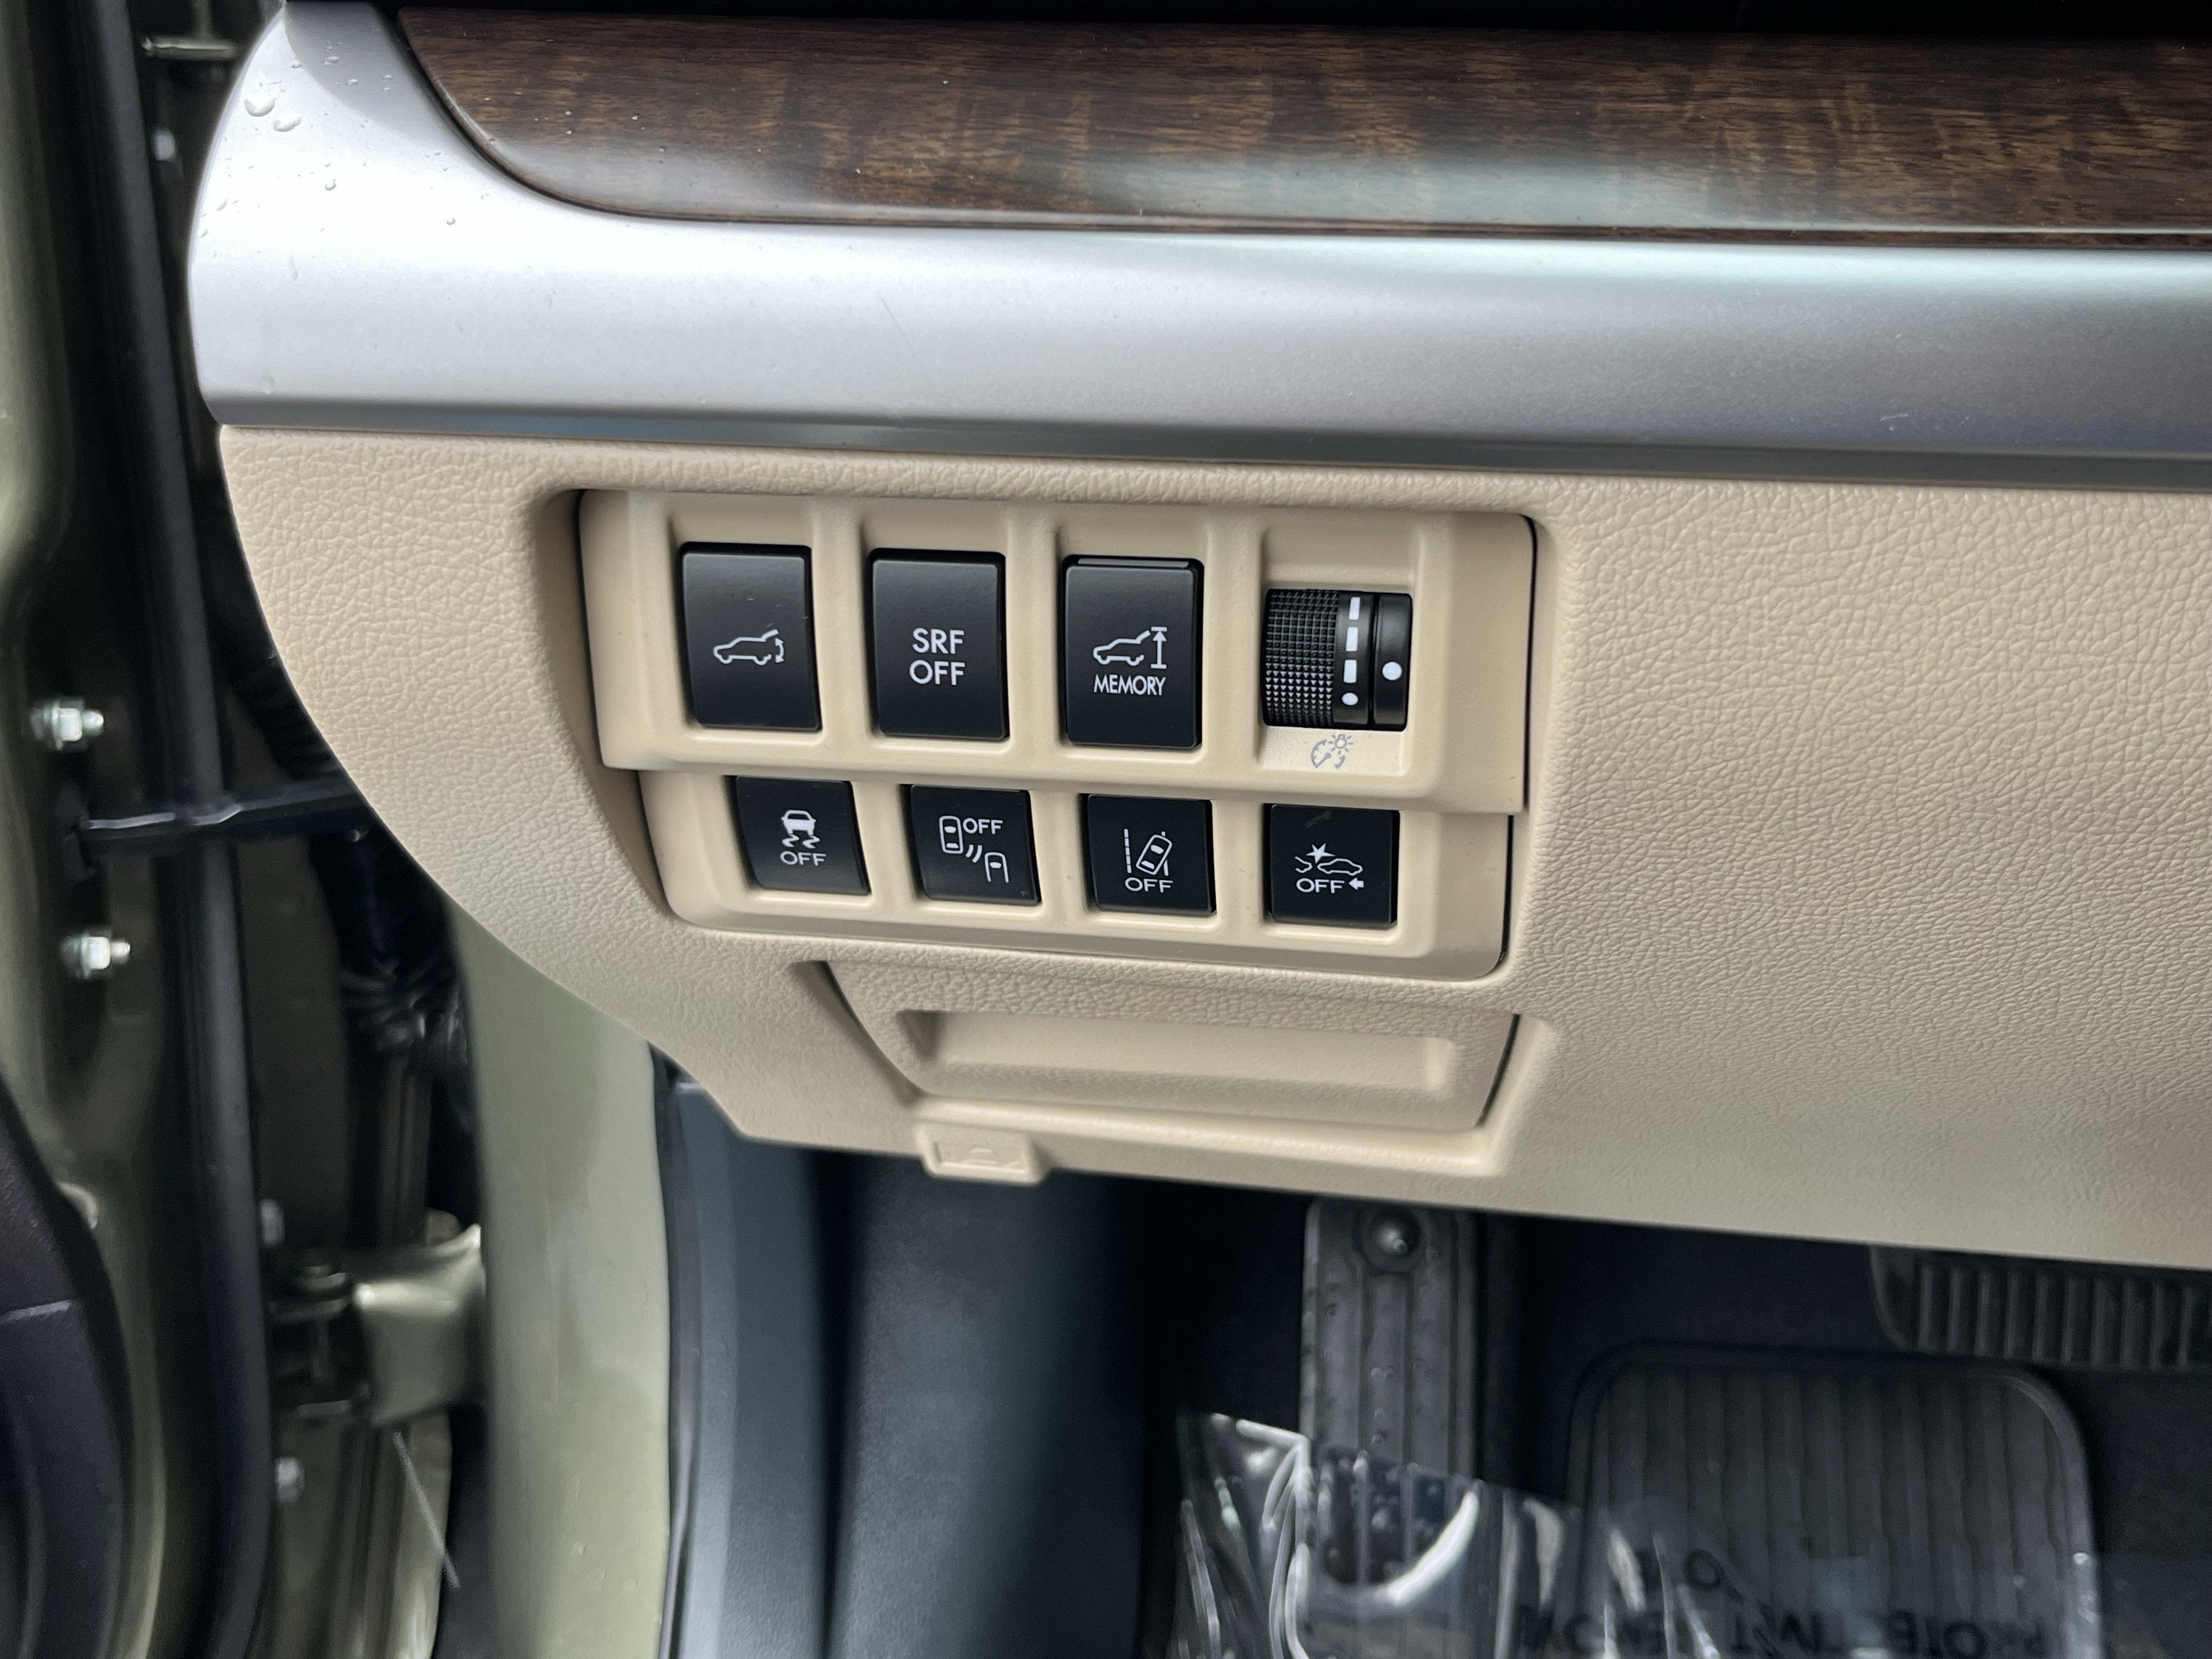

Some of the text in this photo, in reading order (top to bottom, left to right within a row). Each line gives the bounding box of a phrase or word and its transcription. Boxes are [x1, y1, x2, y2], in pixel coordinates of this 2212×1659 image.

[912, 628, 964, 654] SRF
[909, 659, 966, 686] OFF
[1093, 674, 1166, 696] MEMORY
[962, 817, 1003, 834] OFF
[780, 851, 827, 866] OFF
[1124, 877, 1173, 893] OFF
[1295, 877, 1346, 894] OFF
